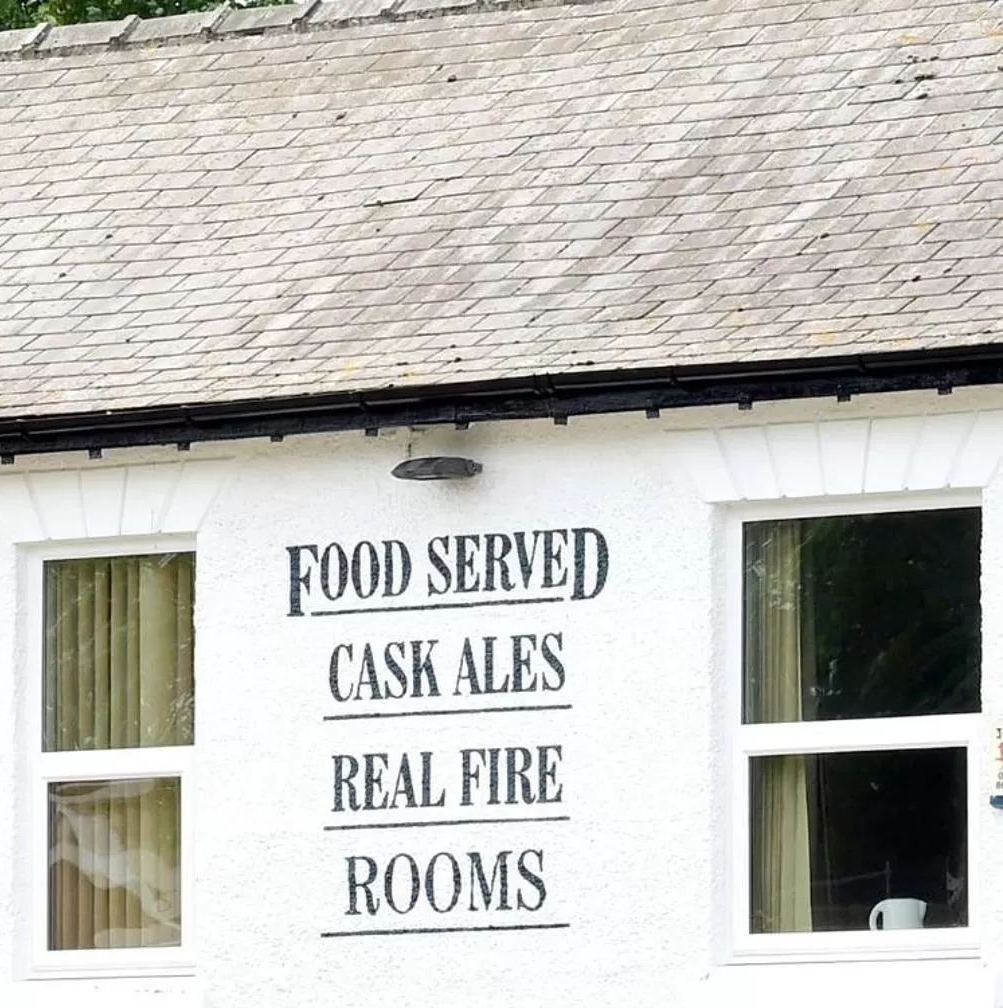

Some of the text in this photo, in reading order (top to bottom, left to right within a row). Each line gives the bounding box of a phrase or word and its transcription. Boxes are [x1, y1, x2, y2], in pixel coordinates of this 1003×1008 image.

[286, 527, 609, 617] FOOD SERVED
[329, 632, 566, 702] CASK ALES
[331, 745, 563, 812] REAL FIRE
[345, 849, 548, 916] ROOMS
